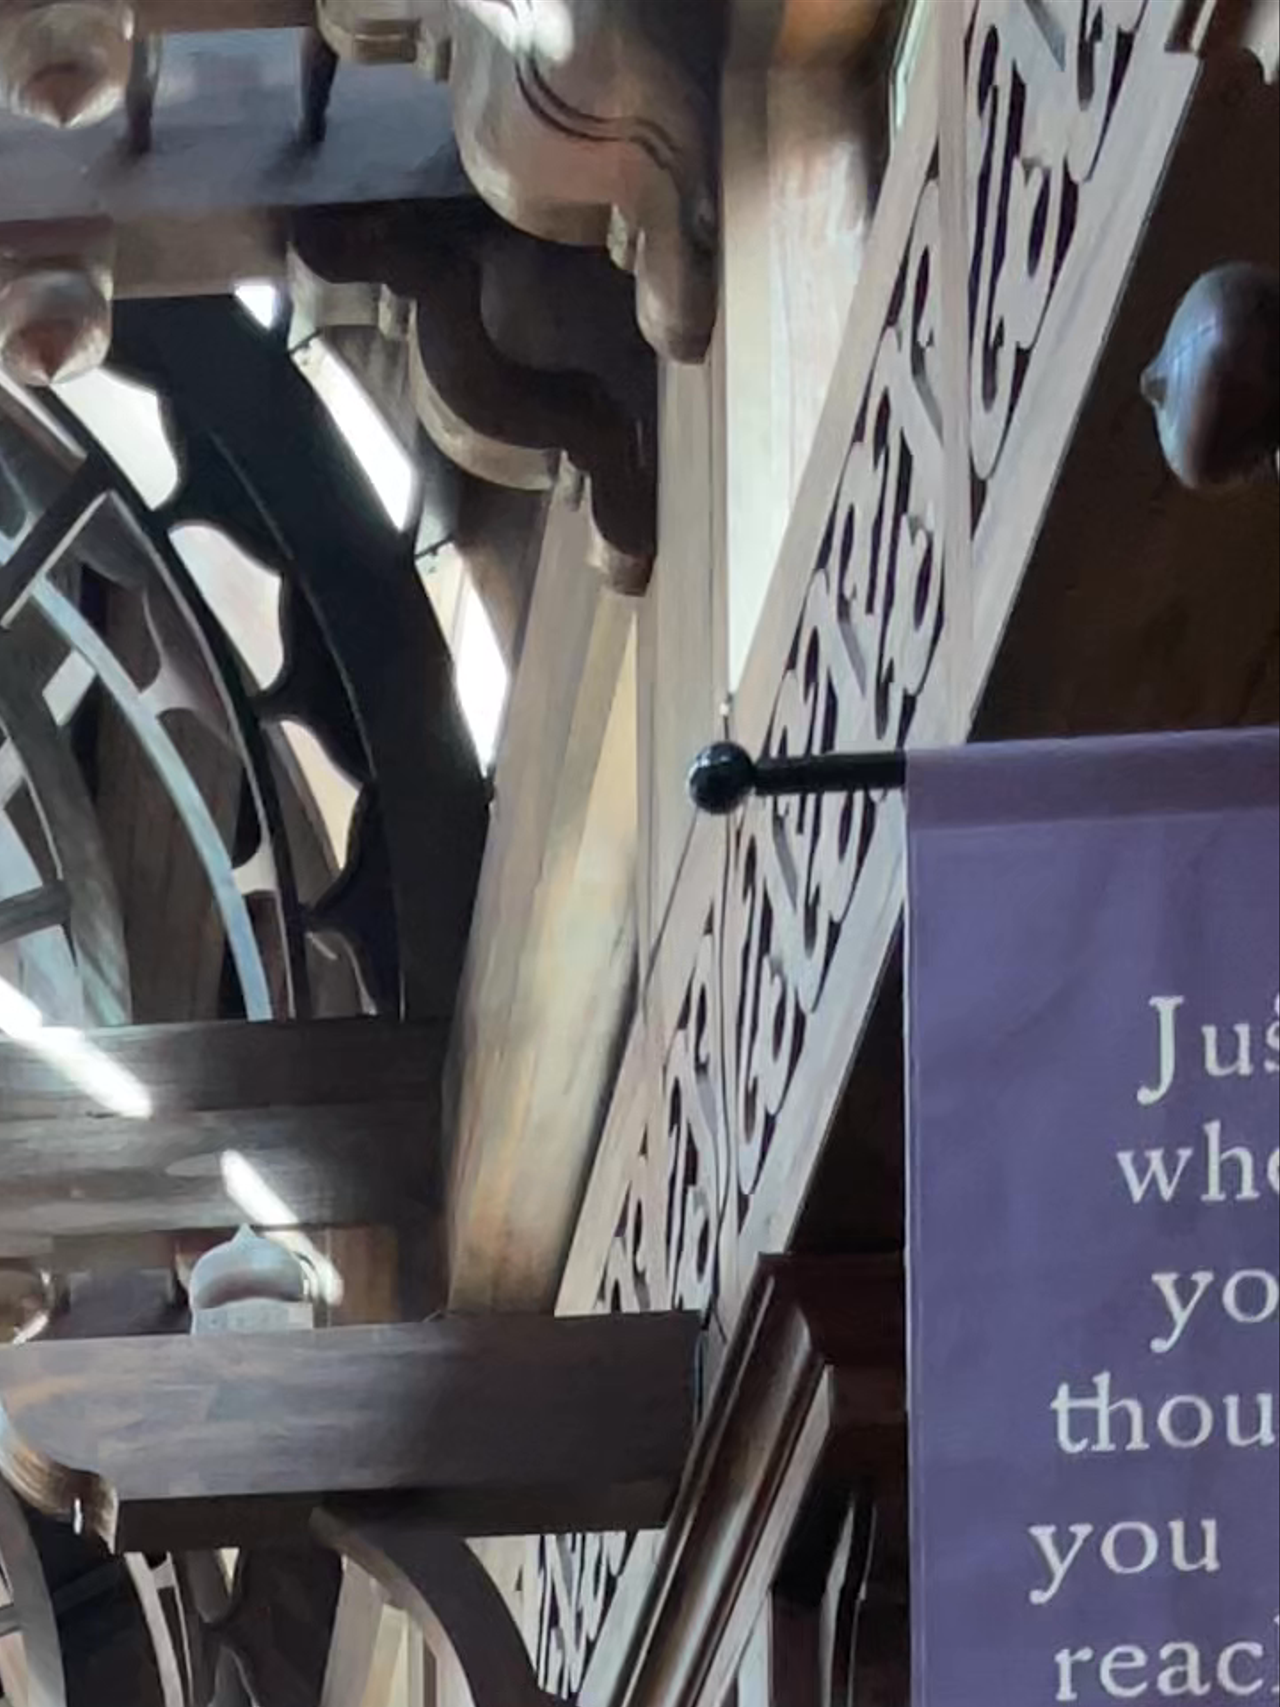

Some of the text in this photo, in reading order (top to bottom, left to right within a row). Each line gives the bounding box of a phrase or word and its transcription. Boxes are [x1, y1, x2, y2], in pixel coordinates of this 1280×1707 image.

[1116, 1120, 1280, 1204] wh
[1050, 1371, 1278, 1454] thou
[1028, 1518, 1221, 1605] you
[1054, 1606, 1280, 1702] reac
